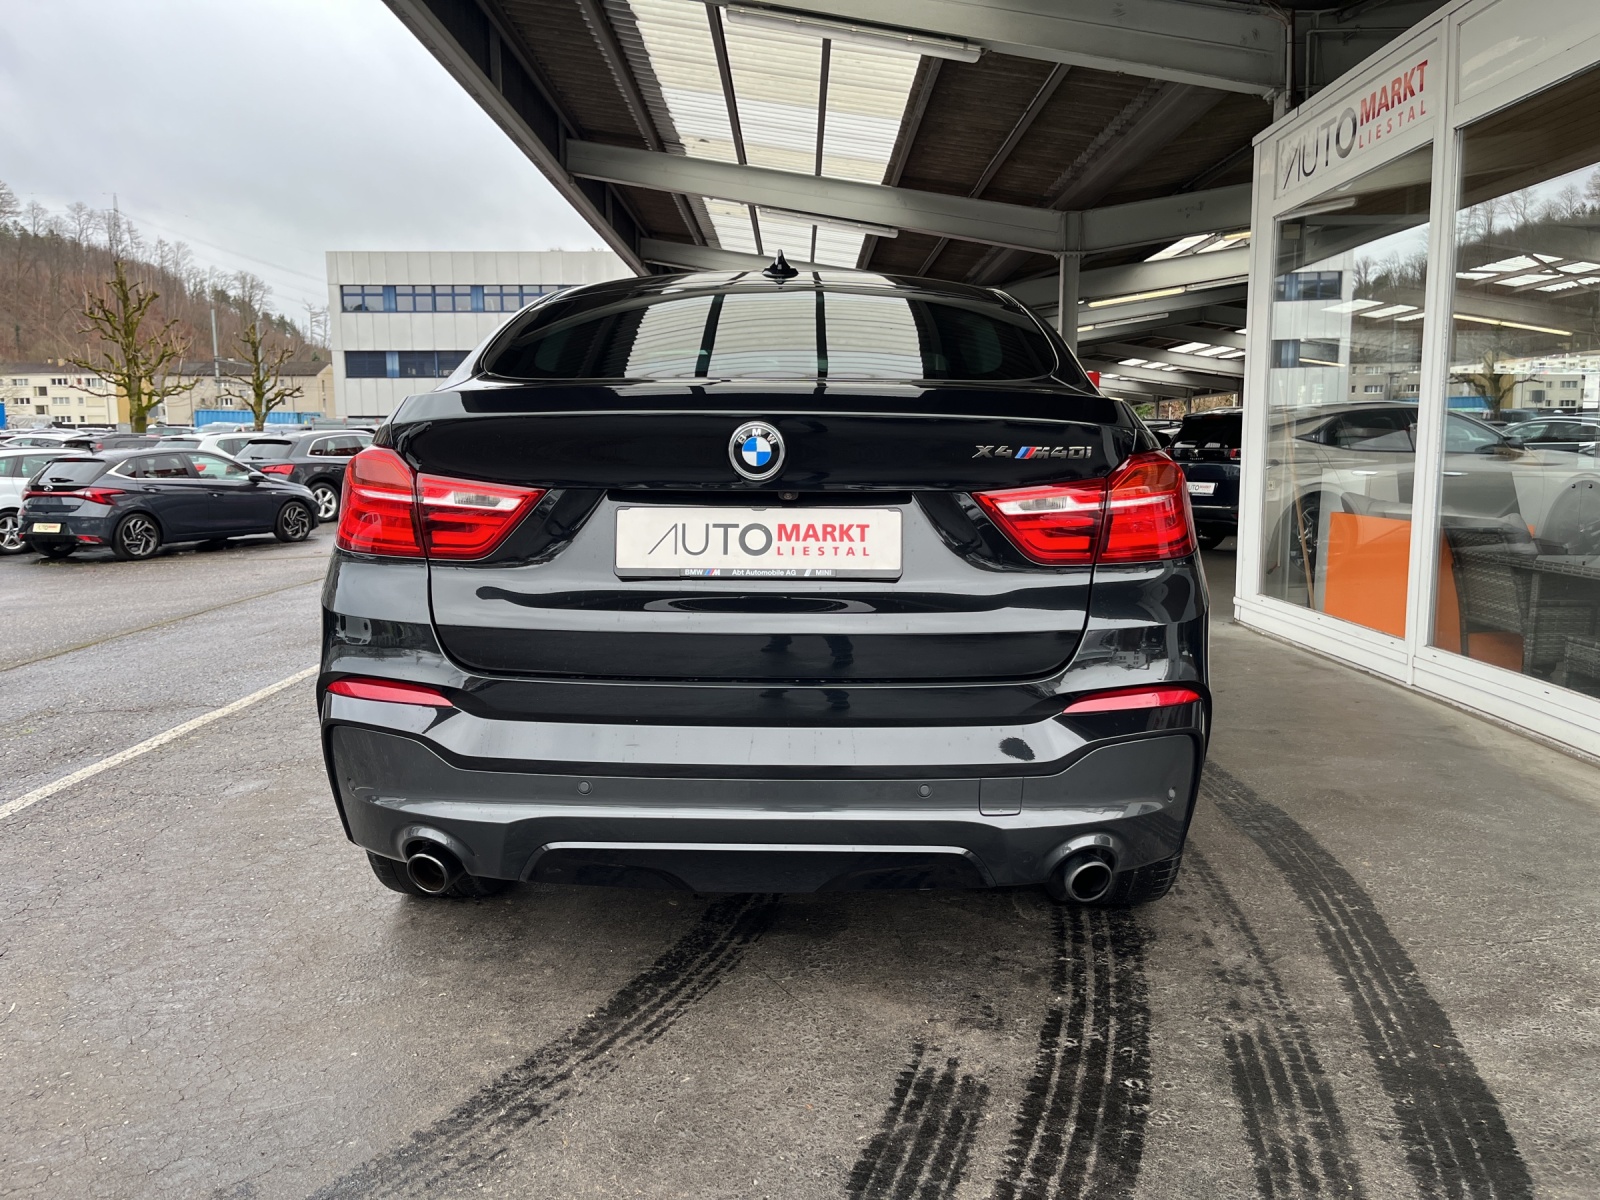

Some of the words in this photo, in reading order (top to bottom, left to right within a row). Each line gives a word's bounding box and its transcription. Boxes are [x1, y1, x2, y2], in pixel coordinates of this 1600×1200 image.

[1283, 107, 1357, 190] AUTO
[1360, 59, 1428, 127] MARKT
[1359, 100, 1426, 149] LIESTAL
[737, 428, 777, 445] BMW
[972, 445, 1013, 459] X4
[648, 523, 773, 556] AUTO
[777, 523, 870, 543] MARKT
[777, 546, 870, 557] LIESTAL
